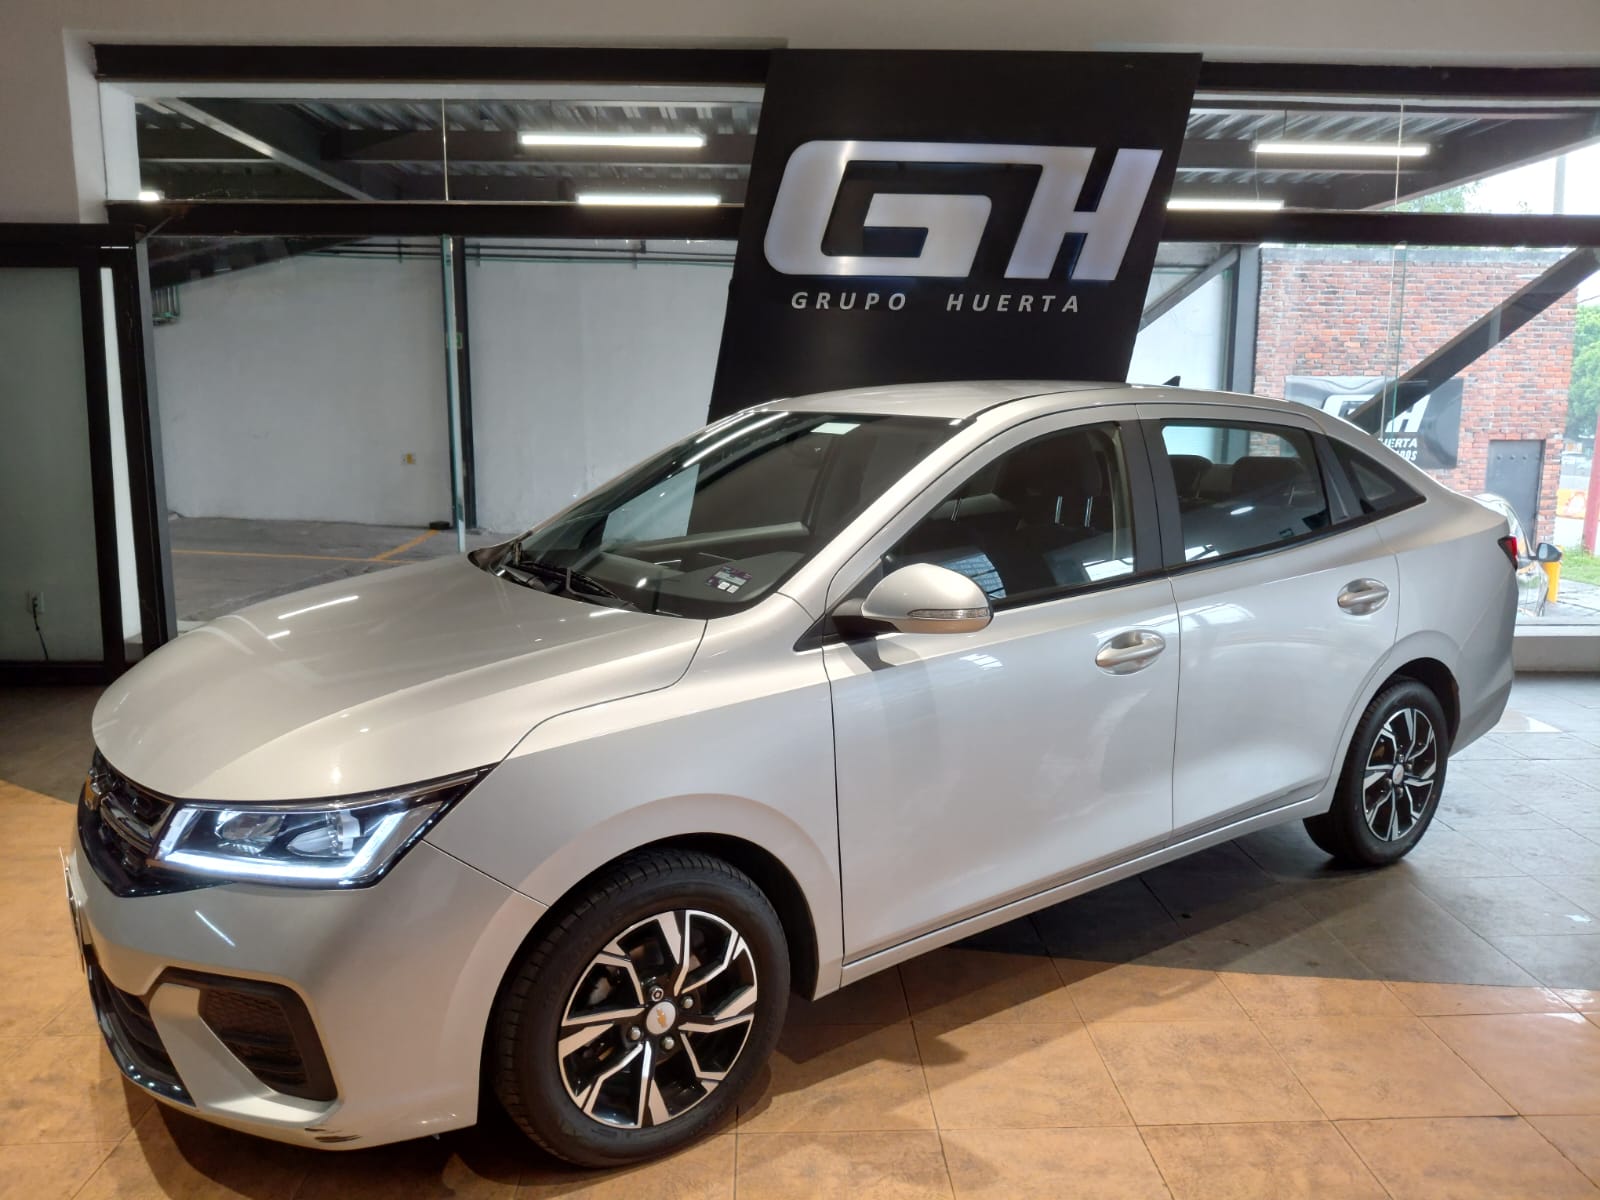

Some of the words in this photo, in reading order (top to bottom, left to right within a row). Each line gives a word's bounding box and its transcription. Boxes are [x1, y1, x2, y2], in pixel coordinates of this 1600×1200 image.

[763, 139, 1163, 281] GH
[791, 291, 906, 311] GRUPO
[946, 293, 1079, 313] HUERTA
[1378, 438, 1418, 448] UERTA
